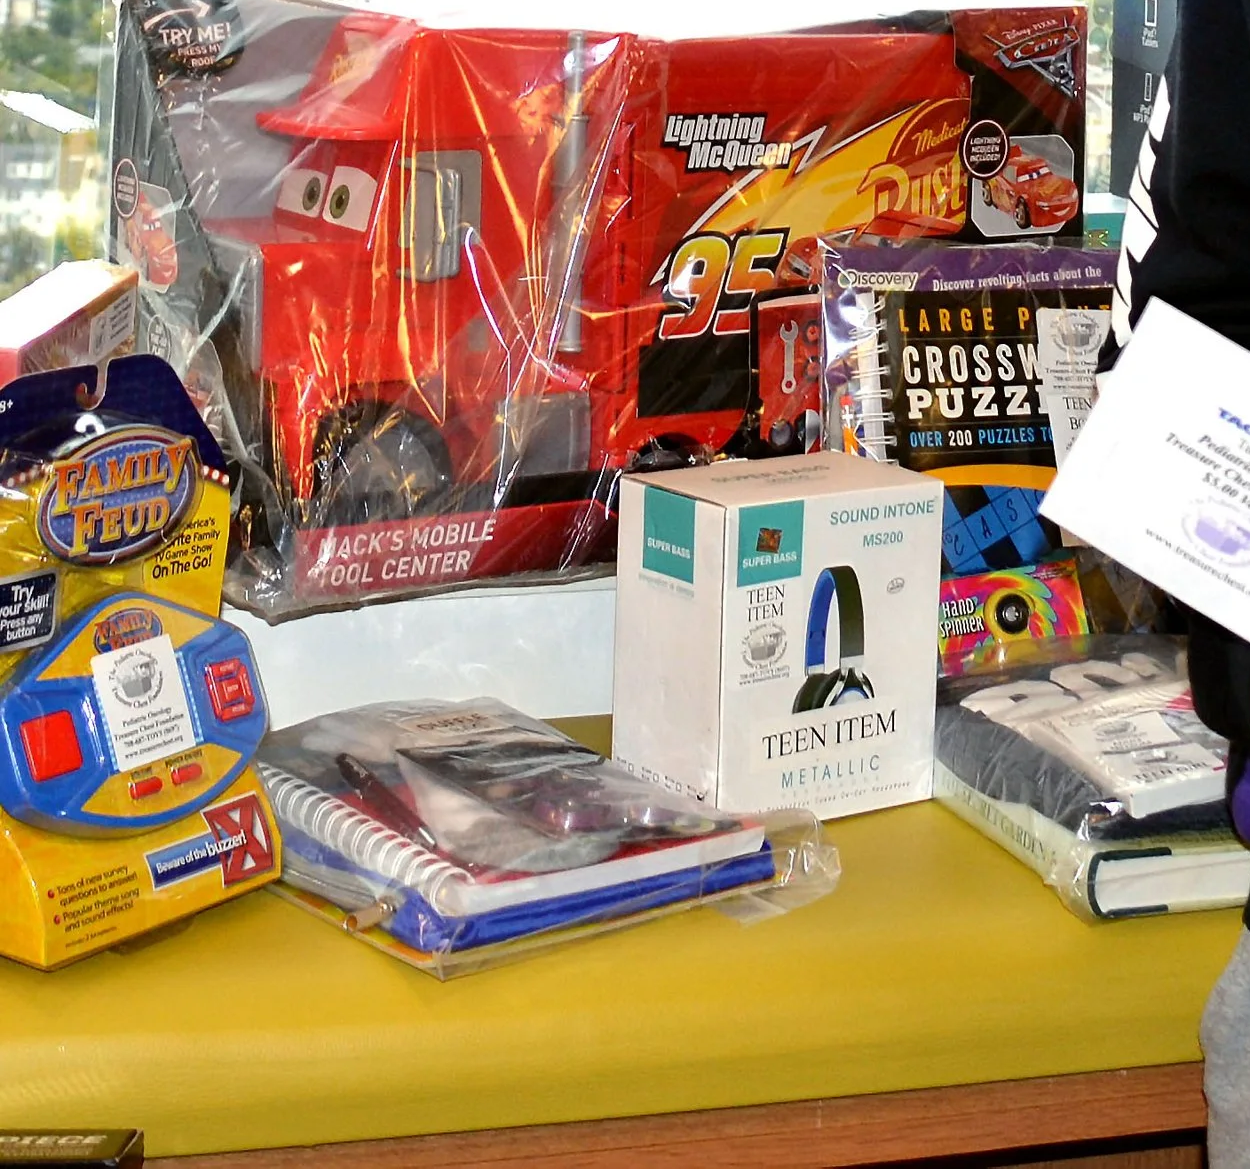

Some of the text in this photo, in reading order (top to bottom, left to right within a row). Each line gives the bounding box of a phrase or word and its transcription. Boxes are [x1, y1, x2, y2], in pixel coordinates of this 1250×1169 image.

[159, 22, 231, 45] TRY ME!
[177, 44, 208, 57] PRESS
[665, 113, 765, 146] Lightning
[687, 142, 792, 170] McQueen
[658, 233, 785, 340] 95
[933, 266, 1102, 291] Discover revolting facts about the
[899, 307, 994, 332] LARGE
[1063, 397, 1092, 410] TEEN
[909, 431, 942, 447] OVER
[948, 429, 972, 446] 200
[978, 426, 1034, 444] PUZZLES
[1165, 431, 1222, 472] Treasure
[51, 438, 192, 517] FAMILY
[830, 499, 935, 526] SOUND INTONE
[68, 496, 170, 557] FEUD
[194, 530, 220, 542] Family
[318, 518, 497, 558] MACK'S MOBILE
[166, 549, 188, 560] Game
[191, 544, 213, 555] Show
[647, 537, 671, 553] SUPER
[863, 531, 903, 548] MS200
[152, 553, 212, 579] On The Go!
[382, 550, 472, 581] CENTER
[743, 551, 797, 568] SUPER BASS
[11, 585, 34, 603] Try
[747, 584, 785, 605] TEEN
[0, 613, 44, 632] Press any
[747, 602, 784, 622] ITEM
[7, 626, 36, 642] button
[762, 709, 898, 760] TEEN ITEM
[781, 755, 880, 789] METALLIC
[156, 829, 247, 875] Beware of the buzzer!
[57, 880, 76, 894] Tons
[103, 865, 128, 881] survey
[59, 886, 98, 907] questions
[99, 882, 108, 893] to
[62, 887, 140, 922] Popular theme song
[65, 919, 80, 932] and
[81, 911, 106, 927] sound
